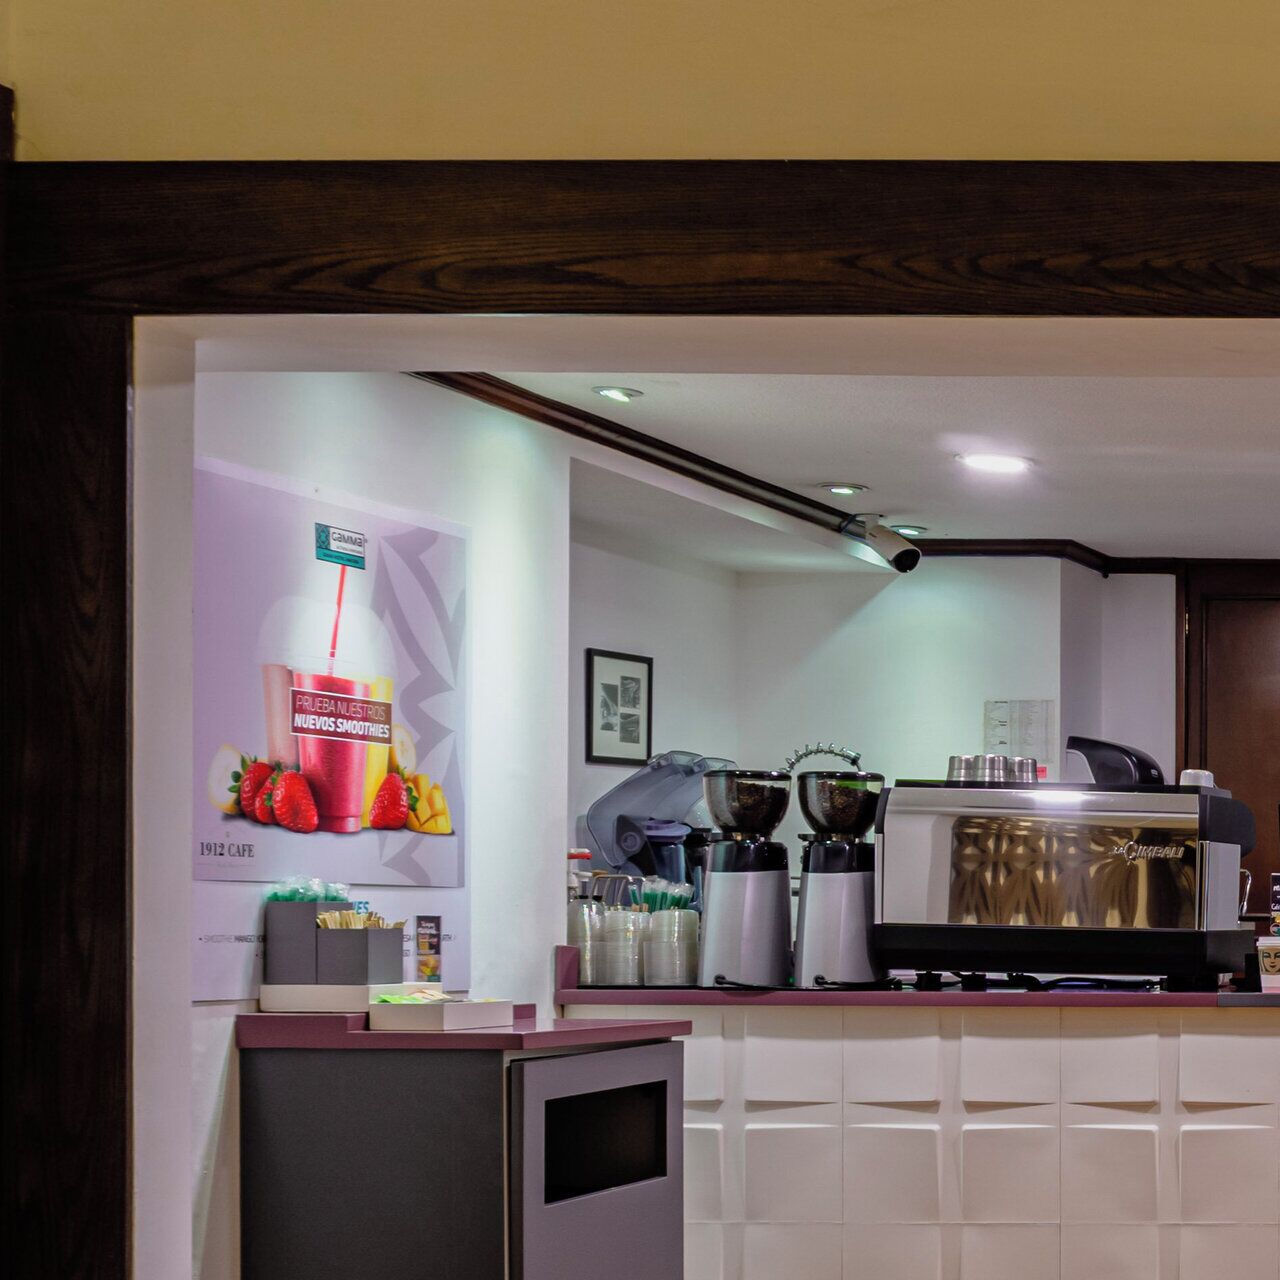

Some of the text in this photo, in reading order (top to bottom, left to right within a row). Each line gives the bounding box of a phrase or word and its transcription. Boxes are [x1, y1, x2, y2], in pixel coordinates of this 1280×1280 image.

[296, 695, 385, 720] PRUEBA NUESTROS
[294, 713, 390, 738] NUEVOS SMOOTHIES
[200, 842, 254, 857] 1912 CAFE
